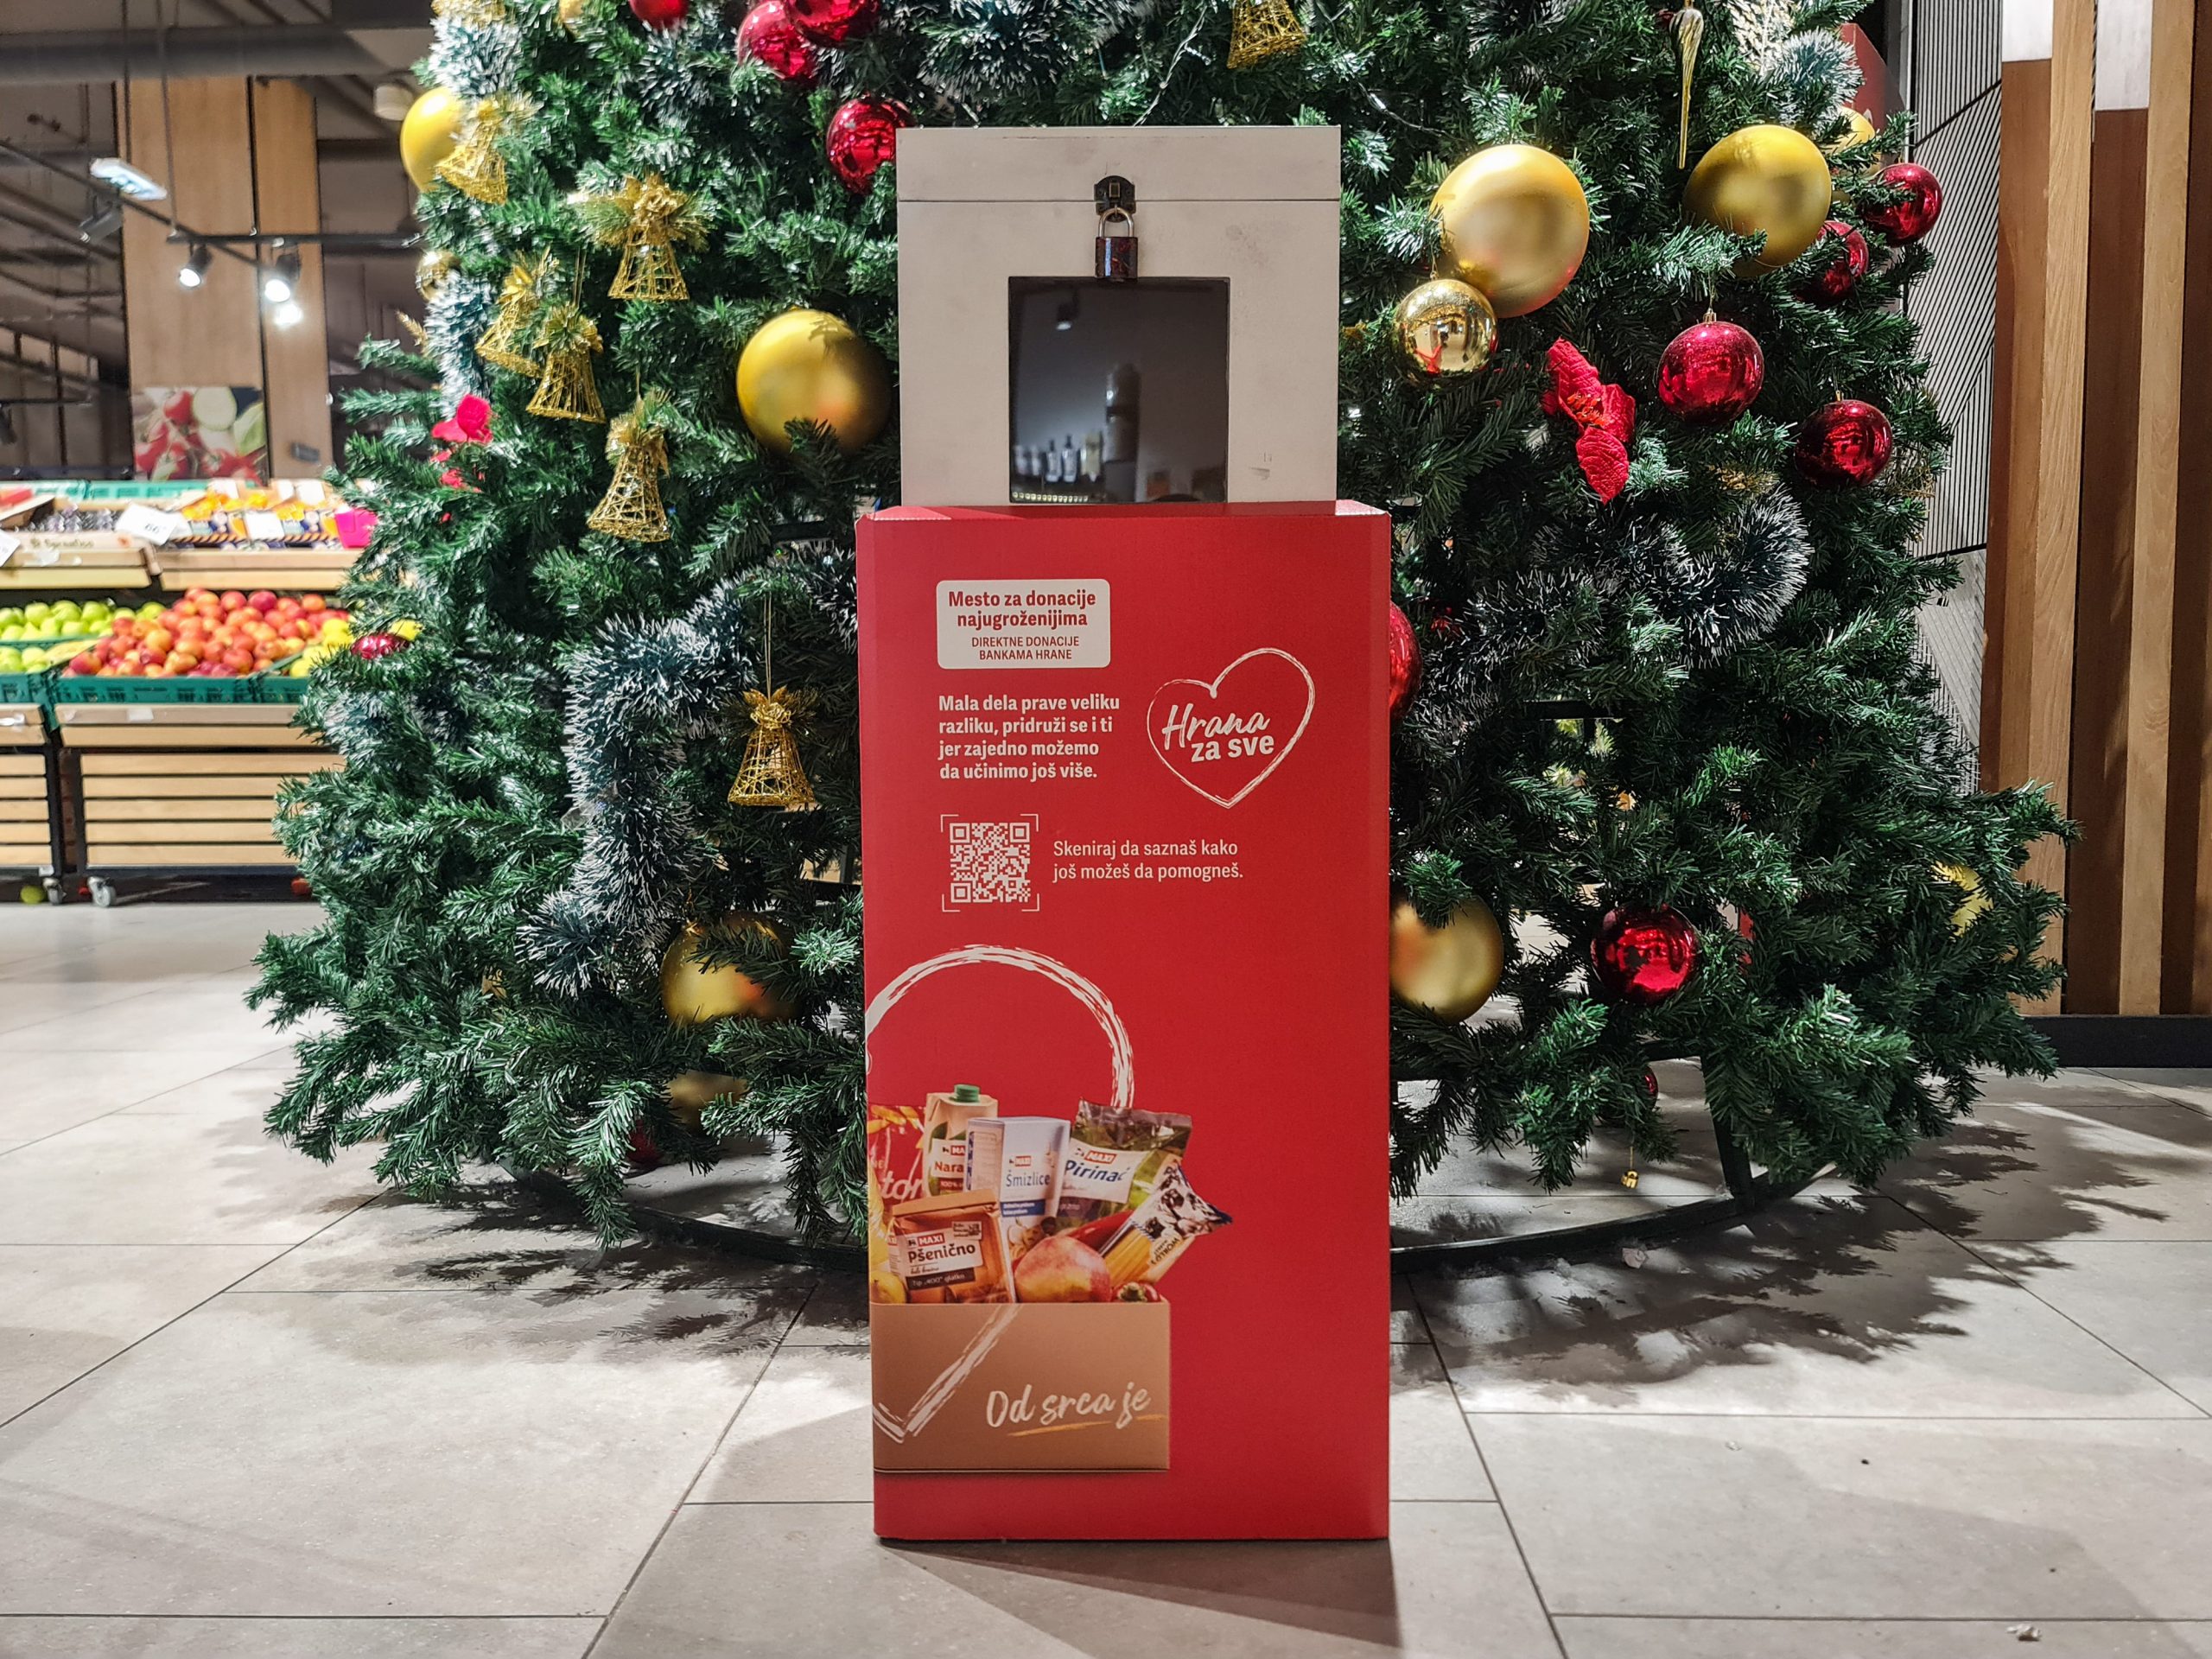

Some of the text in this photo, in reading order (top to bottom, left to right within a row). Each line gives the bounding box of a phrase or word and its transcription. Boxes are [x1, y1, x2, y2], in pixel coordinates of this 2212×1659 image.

[949, 590, 1096, 609] Mesto za donacije
[957, 610, 1088, 630] najugroženijima
[971, 636, 1079, 648] DIREKTNE DONACIJE
[979, 649, 1072, 660] BANKAMA HRANE
[938, 693, 1120, 715] Mala dela prave veliku
[939, 715, 1113, 738] razliku, pridruži se i ti
[1161, 702, 1272, 750] Hrana
[938, 740, 1099, 761] jer zajedno možemo
[1191, 734, 1275, 762] za sve
[939, 761, 1097, 783] da učinimo još više.
[1053, 838, 1238, 861] Skeniraj da saznaš kako
[1052, 861, 1243, 884] još možeš da pomogneš.
[1087, 1151, 1116, 1163] MAXI
[1006, 1169, 1051, 1187] Šmizlice
[918, 1235, 944, 1246] MAXI
[908, 1243, 976, 1263] Pšenično
[986, 1381, 1153, 1430] Od srca je
